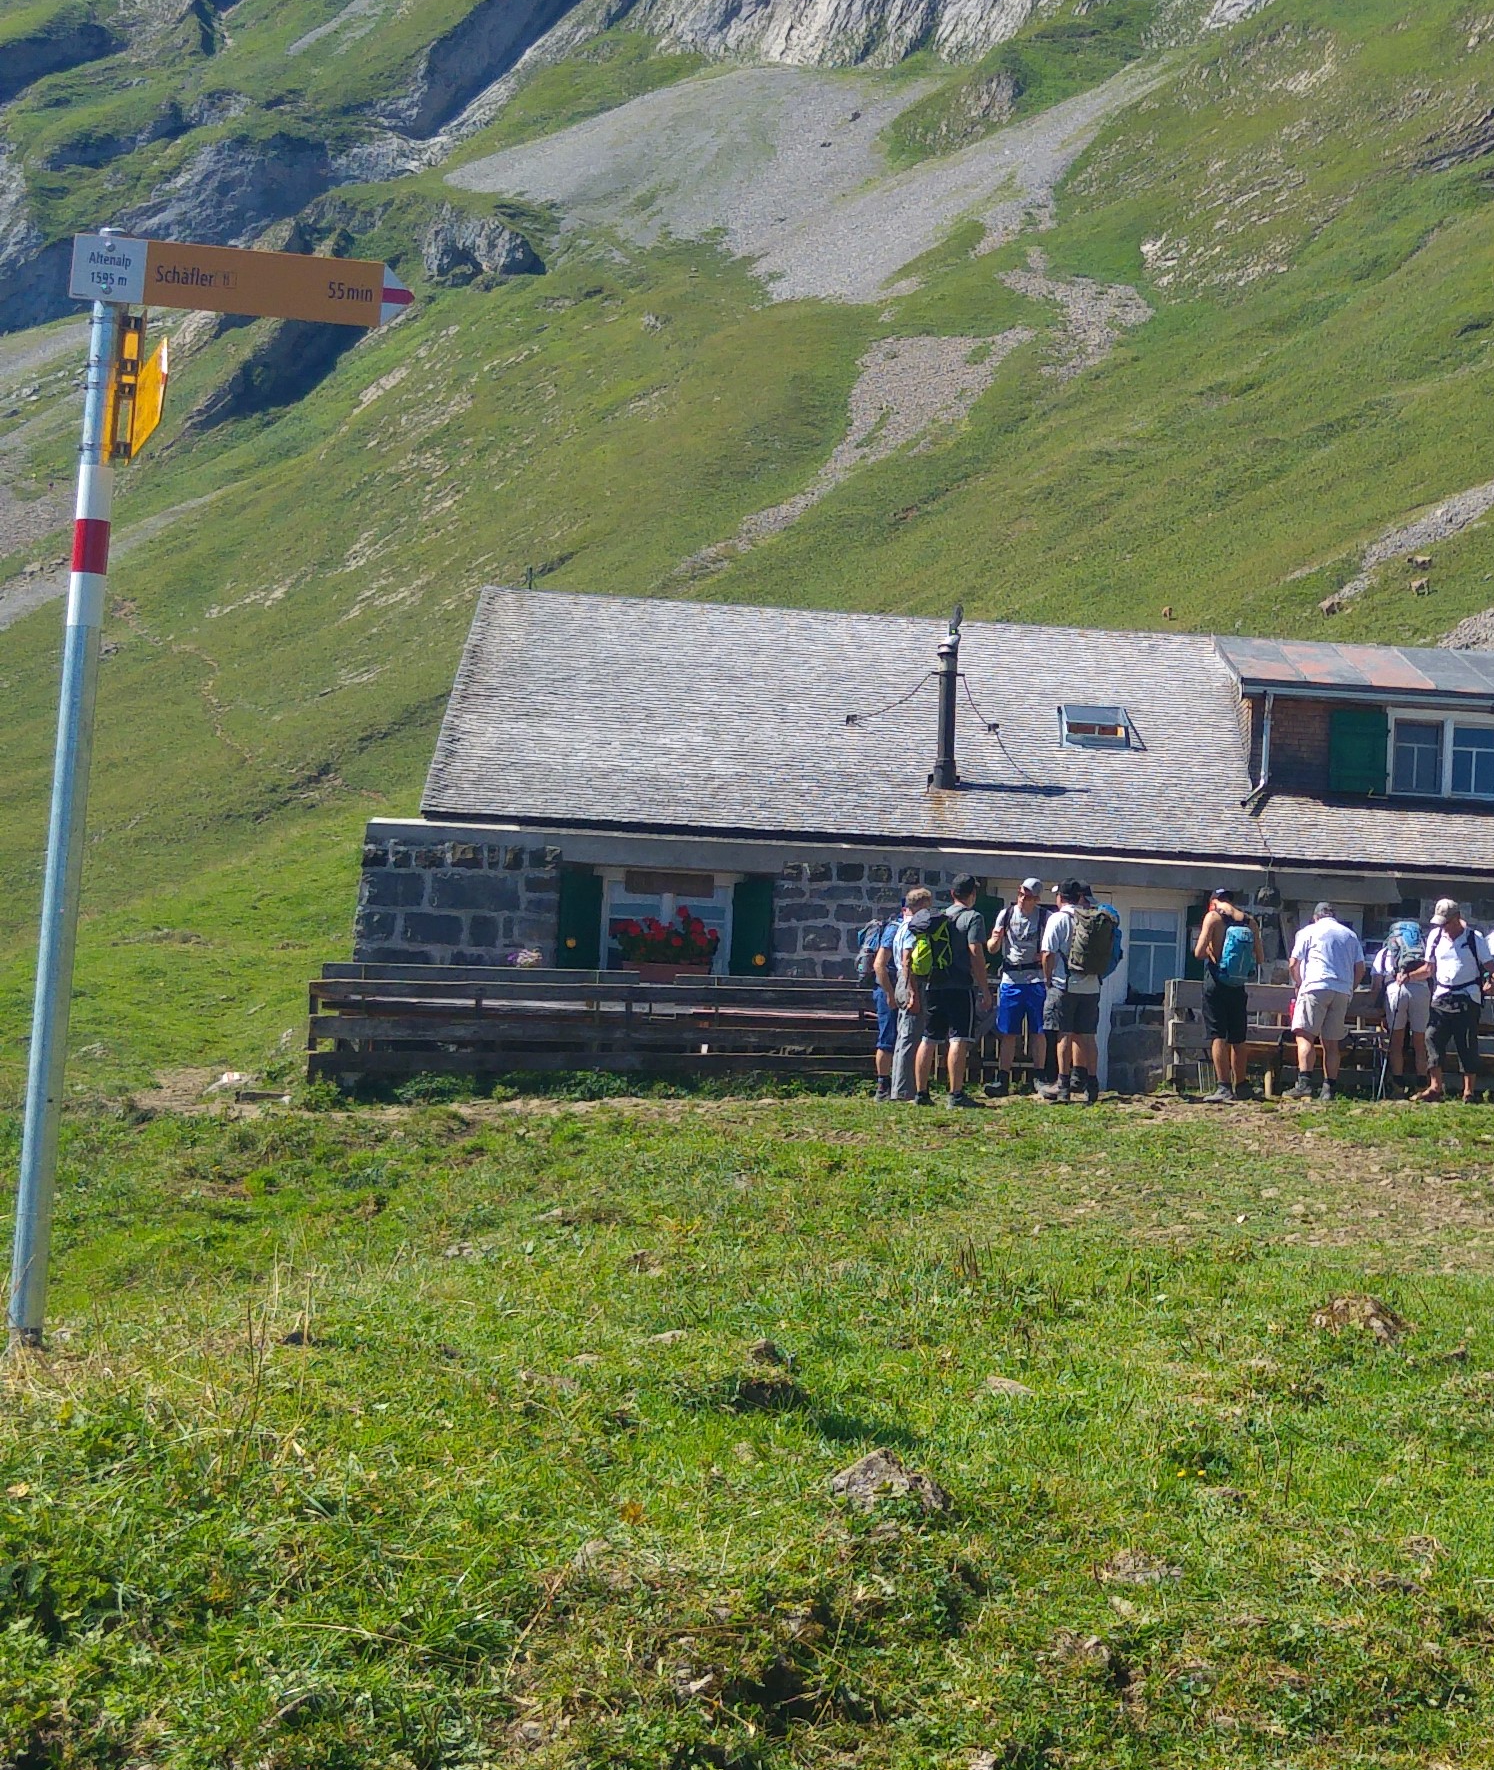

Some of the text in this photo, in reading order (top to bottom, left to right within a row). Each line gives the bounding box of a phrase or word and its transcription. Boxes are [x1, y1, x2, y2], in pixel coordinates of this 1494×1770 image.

[89, 251, 132, 270] Altenalp
[90, 271, 127, 286] 1595 m
[155, 265, 214, 287] Schäfler
